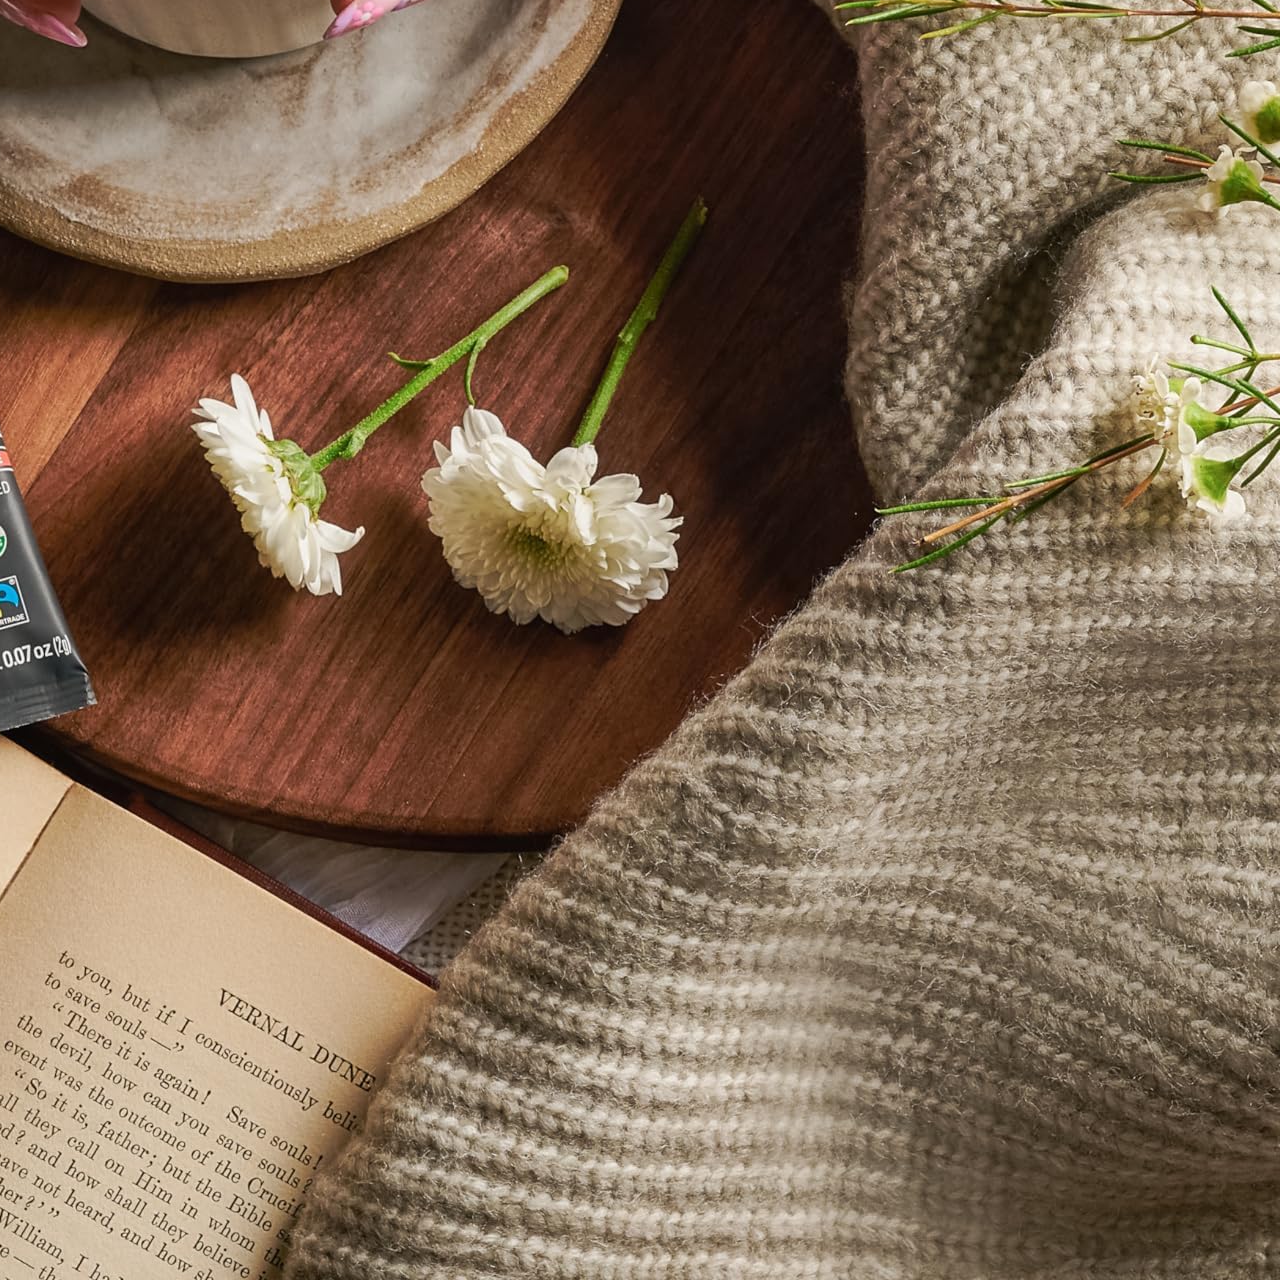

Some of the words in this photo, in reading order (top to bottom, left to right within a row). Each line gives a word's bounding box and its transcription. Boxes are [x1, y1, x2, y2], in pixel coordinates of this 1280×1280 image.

[2, 644, 32, 668] 0.07
[33, 642, 53, 661] oz
[16, 1015, 43, 1039] the
[49, 1032, 93, 1073] devil,
[101, 1061, 138, 1092] how
[142, 1091, 172, 1115] can
[174, 1111, 210, 1137] you
[215, 1134, 253, 1161] save
[58, 950, 75, 969] to
[75, 965, 113, 996] you,
[121, 983, 151, 1013] but
[155, 1004, 177, 1026] if
[176, 1017, 194, 1036] I
[195, 1033, 319, 1112] conscientiously
[219, 988, 305, 1052] VERNAL
[309, 1043, 377, 1092] DUNE
[4, 1040, 48, 1071] event
[53, 1066, 84, 1092] was
[87, 1086, 114, 1110] the
[118, 1107, 186, 1152] outcome
[190, 1149, 214, 1166] of
[214, 1159, 241, 1184] the
[23, 1108, 62, 1139] they
[66, 1136, 100, 1161] call
[104, 1158, 125, 1177] on
[132, 1169, 173, 1205] Him
[179, 1197, 199, 1220] in
[208, 1216, 256, 1253] whom
[31, 1175, 61, 1199] not
[63, 1188, 116, 1234] heard,
[120, 1227, 155, 1252] and
[155, 1241, 193, 1273] how
